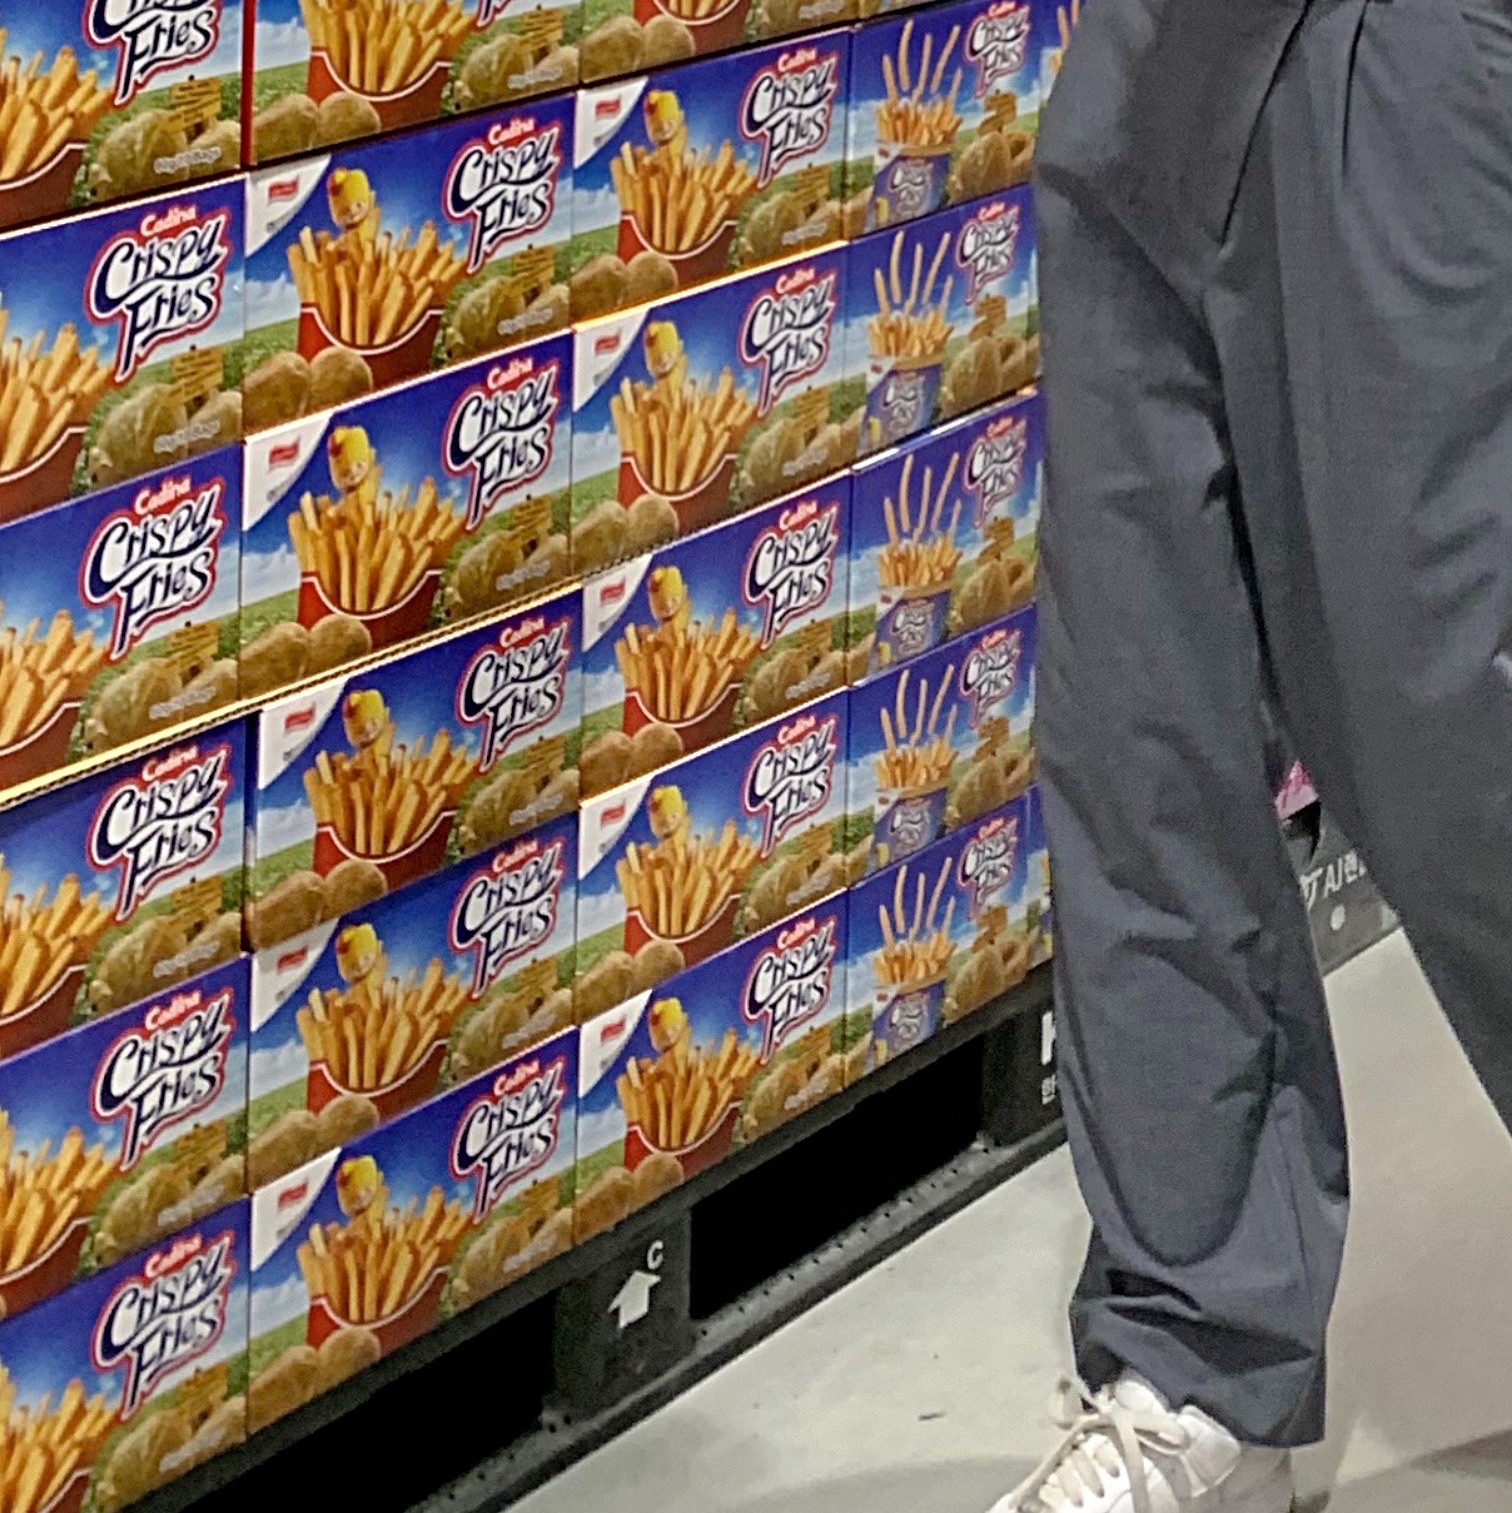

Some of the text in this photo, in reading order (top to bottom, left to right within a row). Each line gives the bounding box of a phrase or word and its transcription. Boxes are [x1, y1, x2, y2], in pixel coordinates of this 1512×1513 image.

[115, 8, 214, 105] Fries
[747, 55, 837, 123] Crispy
[449, 132, 556, 216] Crispy
[758, 102, 826, 187] Fries
[93, 216, 225, 317] Crispy
[141, 206, 197, 237] Cadina
[467, 183, 550, 272] Fries
[116, 274, 215, 381] Fries
[746, 274, 837, 356] Crispy
[758, 324, 826, 418] Fries
[447, 368, 556, 470] Crispy
[134, 479, 191, 514] Cadina
[468, 424, 549, 530] Fries
[87, 487, 223, 600] Crispy
[748, 507, 839, 592] Crispy
[110, 546, 211, 659] Fries
[762, 562, 828, 651] Fries
[464, 626, 566, 721] Crispy
[143, 747, 199, 780] Cadina
[483, 686, 558, 771] Fries
[749, 721, 837, 811] Crispy
[95, 754, 227, 864] Crispy
[761, 767, 829, 857] Fries
[117, 810, 216, 920] Fries
[458, 845, 562, 948] Crispy
[473, 897, 555, 997] Fries
[747, 925, 837, 1015] Crispy
[97, 1000, 229, 1116] Crispy
[145, 993, 200, 1029] Cadina
[763, 972, 829, 1062] Fries
[120, 1058, 218, 1169] Fries
[459, 1067, 563, 1174] Crispy
[477, 1117, 556, 1223] Fries
[145, 1236, 200, 1273] Cadina
[97, 1242, 229, 1367] Crispy
[121, 1298, 218, 1421] Fries
